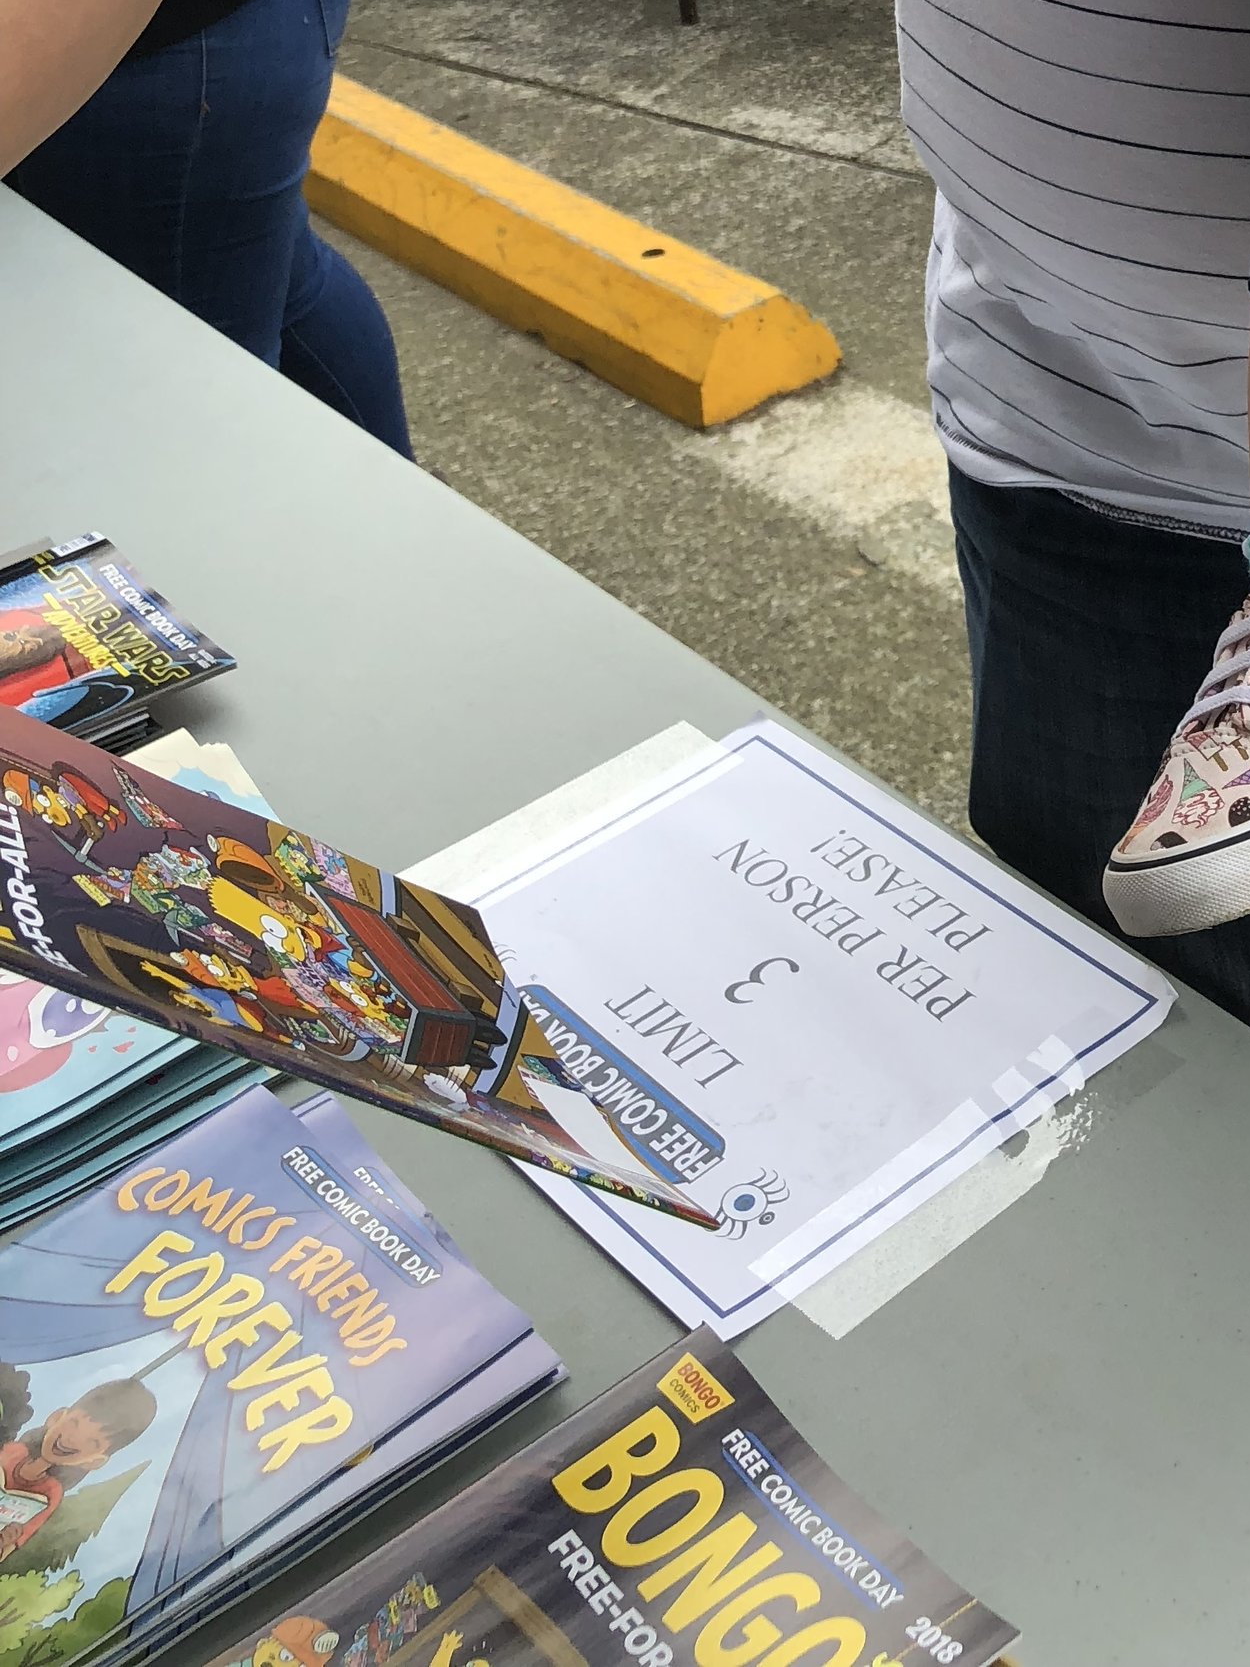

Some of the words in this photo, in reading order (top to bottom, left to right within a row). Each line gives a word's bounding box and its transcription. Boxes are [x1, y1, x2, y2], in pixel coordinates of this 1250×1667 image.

[38, 564, 122, 634] STAR
[102, 620, 190, 686] WARS
[42, 609, 118, 670] ADVENTURES
[100, 563, 127, 590] FREE
[119, 585, 155, 616] COMIC
[149, 606, 181, 638] BOOK
[172, 633, 199, 652] DAY
[712, 838, 887, 957] PERSON
[809, 828, 995, 953] PLEASE!
[723, 956, 800, 1005] 3
[876, 943, 977, 1024] PER
[543, 1018, 605, 1079] BOOK
[603, 983, 744, 1090] LIMIT
[585, 1067, 667, 1136] COMIC
[650, 1123, 722, 1182] FREE
[282, 1146, 325, 1185] FREE
[316, 1179, 370, 1226] COMIC
[360, 1217, 411, 1262] BOOK
[401, 1253, 441, 1285] DAY
[117, 1166, 297, 1250] COMICS
[268, 1235, 408, 1368] FRIENDS
[104, 1229, 354, 1474] FOREVER
[678, 1361, 721, 1410] BONGO
[669, 1378, 700, 1414] COMICS
[721, 1428, 770, 1479] FREE
[760, 1473, 822, 1535] COMIC
[811, 1526, 869, 1580] BOOK
[858, 1568, 904, 1609] DAY
[904, 1616, 963, 1665] 2018
